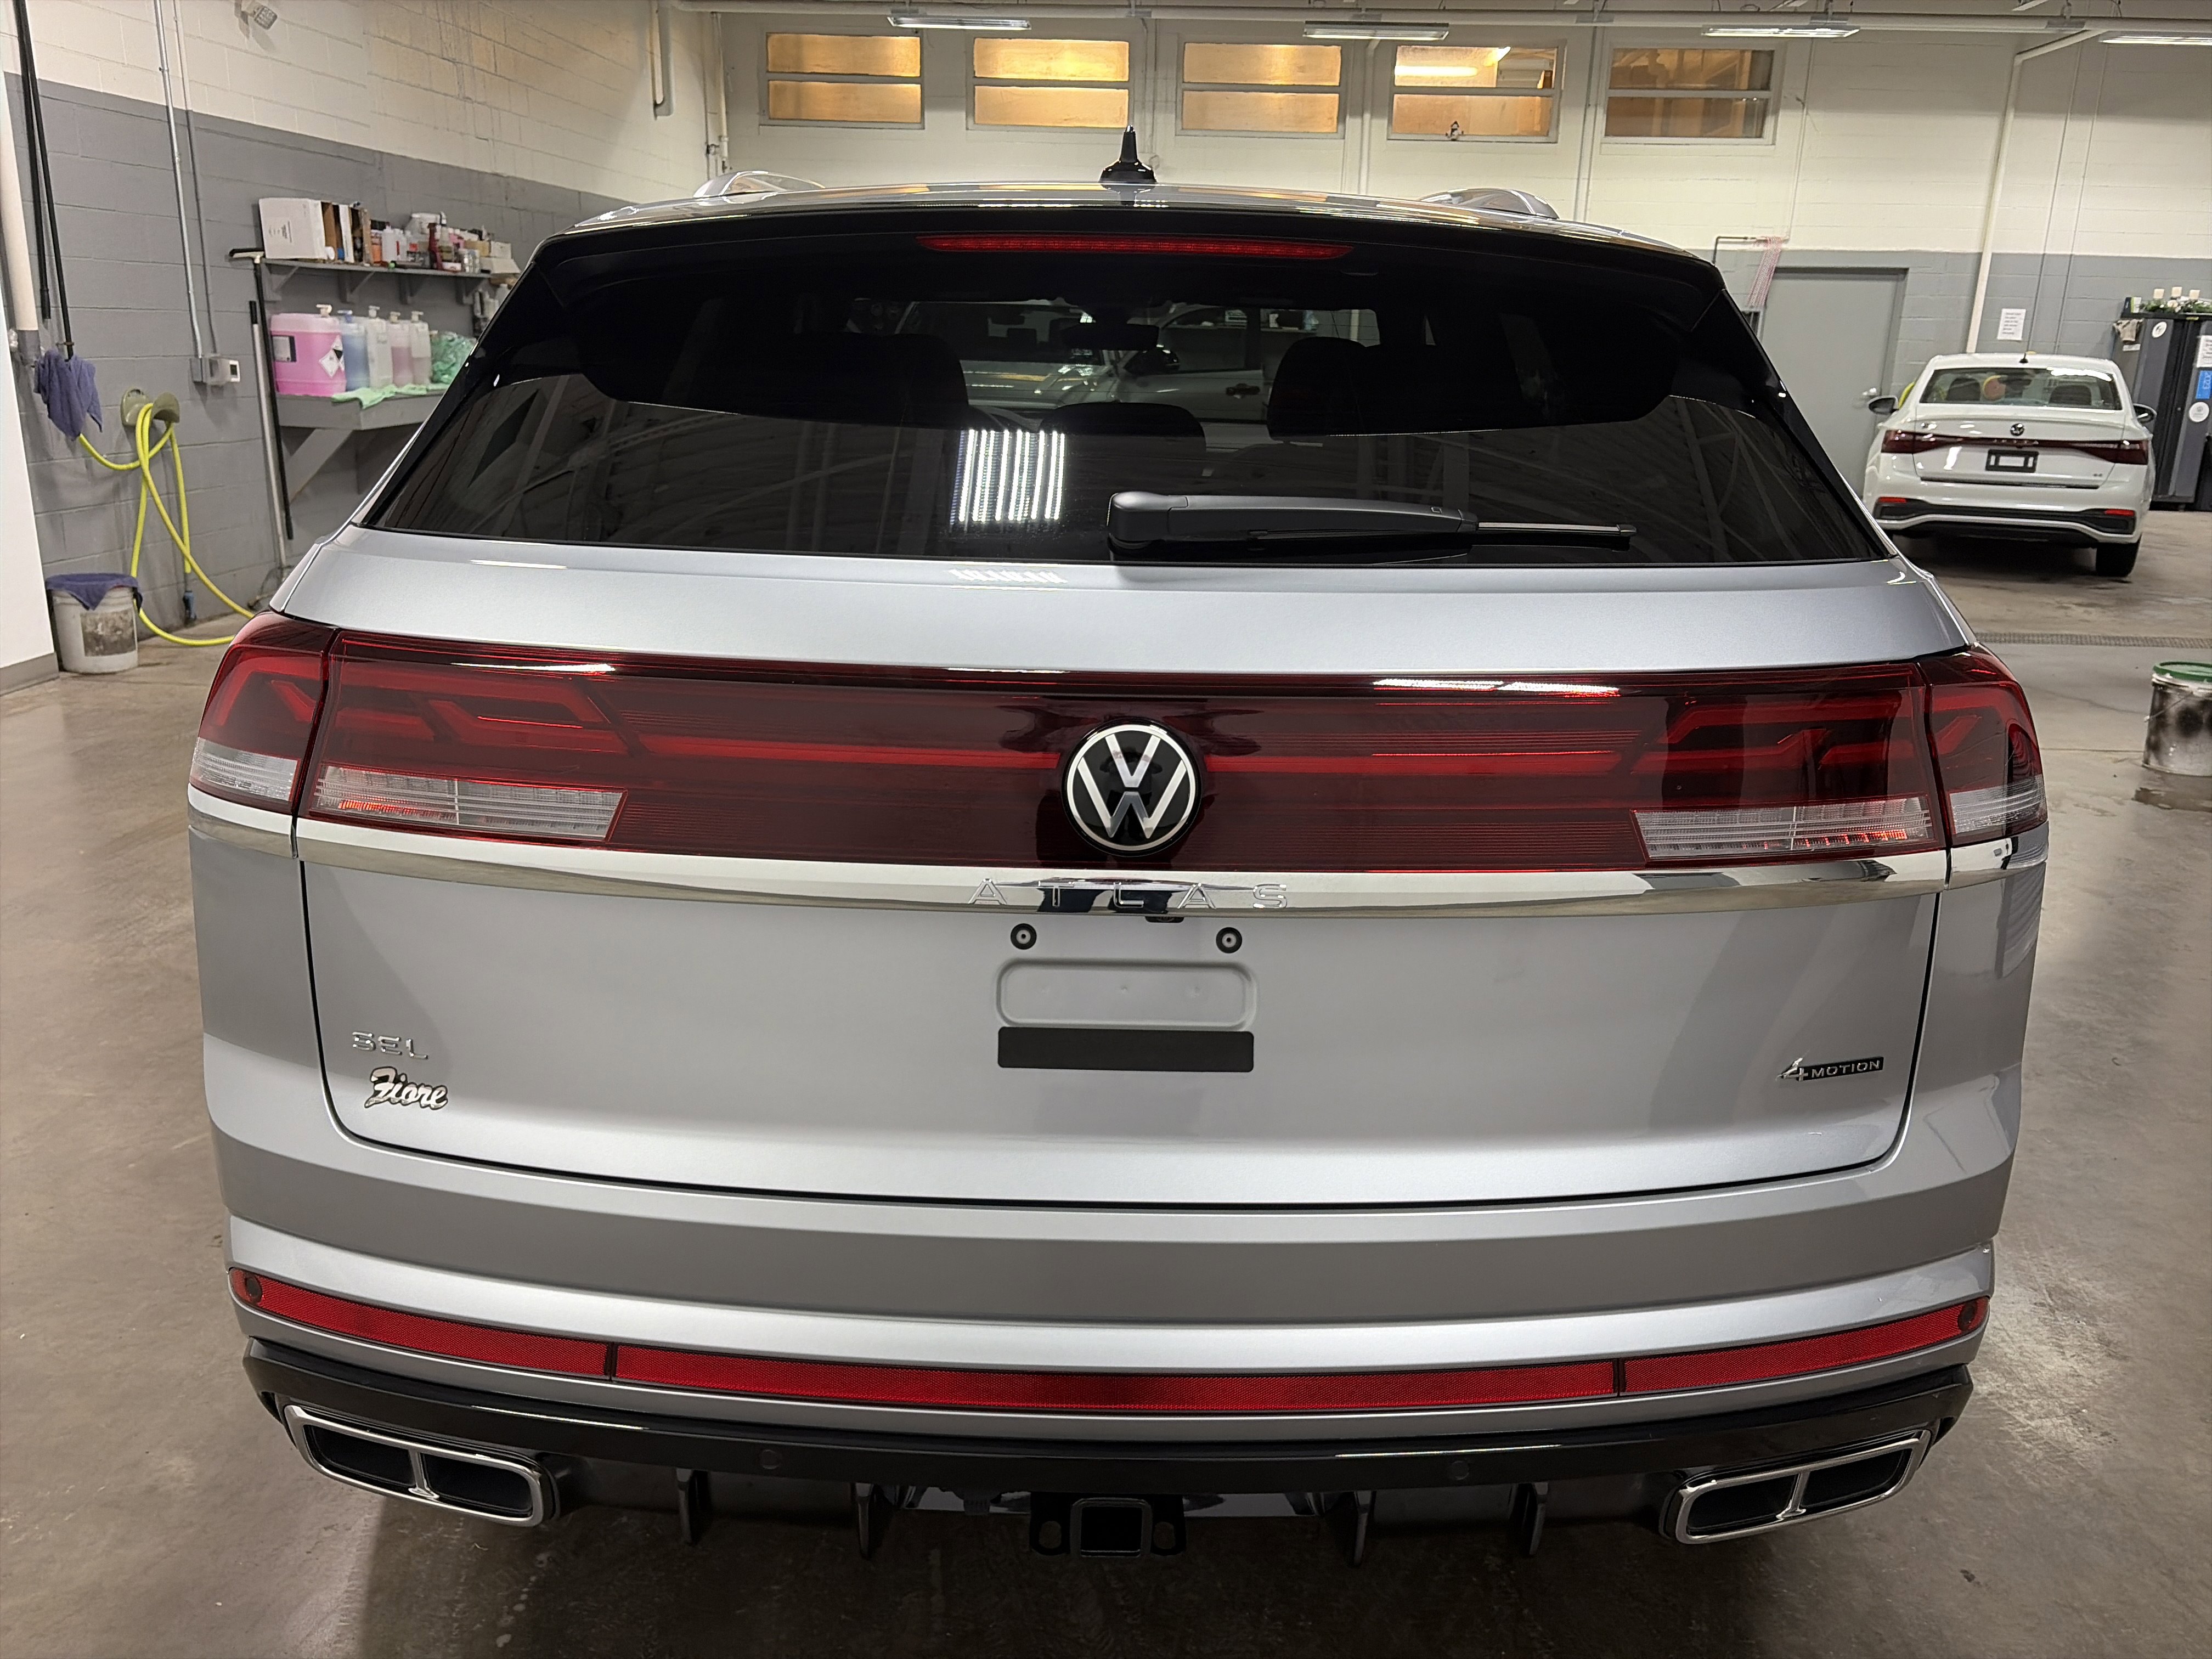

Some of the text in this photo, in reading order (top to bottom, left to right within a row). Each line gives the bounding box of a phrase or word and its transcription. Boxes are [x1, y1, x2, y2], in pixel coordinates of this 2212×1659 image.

[1075, 733, 1188, 839] VW
[967, 878, 1289, 909] ATLAS
[352, 1031, 428, 1059] SEL
[1781, 1057, 1881, 1082] 4MOTION
